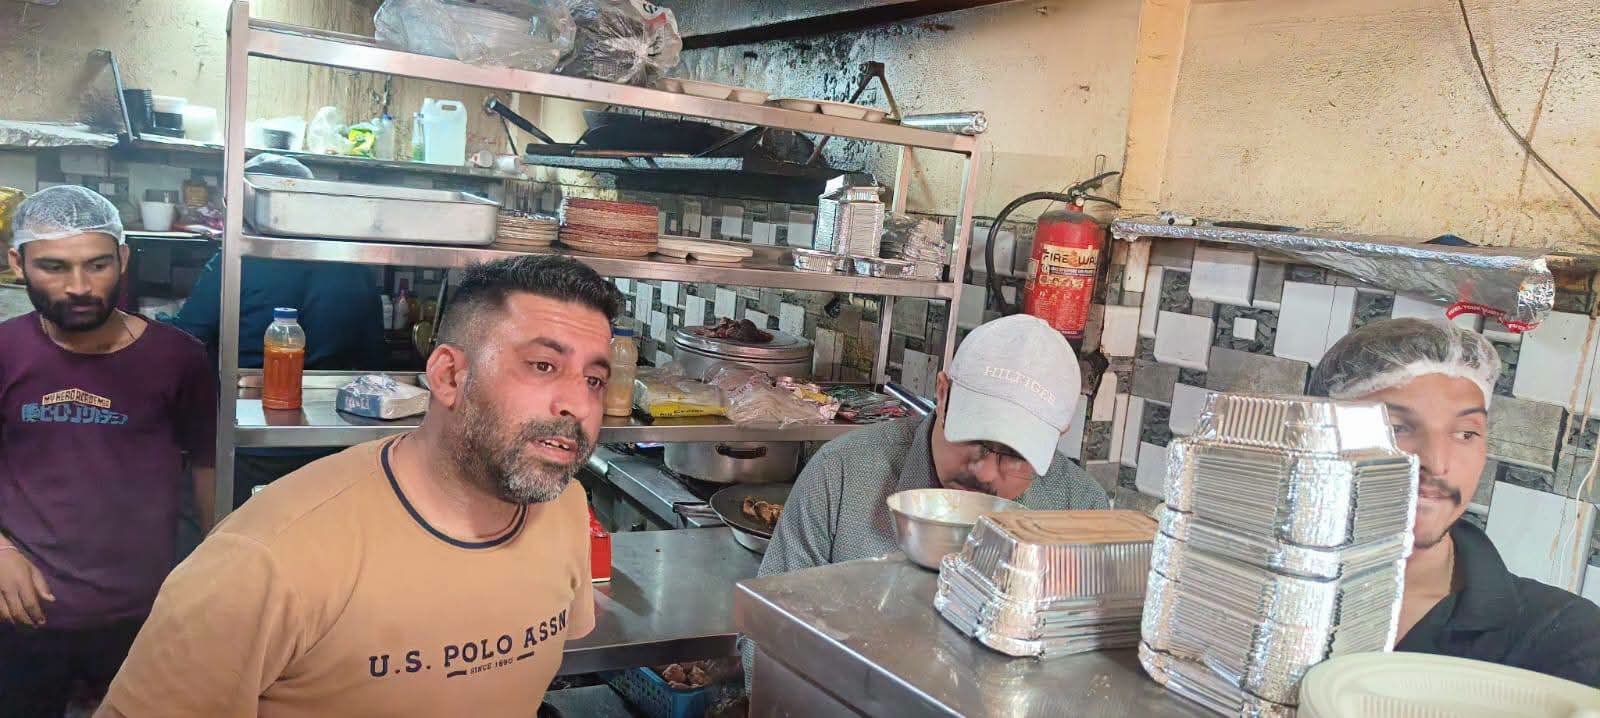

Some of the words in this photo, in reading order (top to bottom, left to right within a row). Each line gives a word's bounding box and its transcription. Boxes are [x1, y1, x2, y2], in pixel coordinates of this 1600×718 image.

[1042, 249, 1069, 264] FIRE
[43, 395, 55, 404] MY
[55, 390, 75, 402] HERO
[368, 650, 431, 677] U.S.
[443, 634, 513, 667] POLO
[523, 609, 567, 649] ASSN
[470, 662, 492, 674] SINCE
